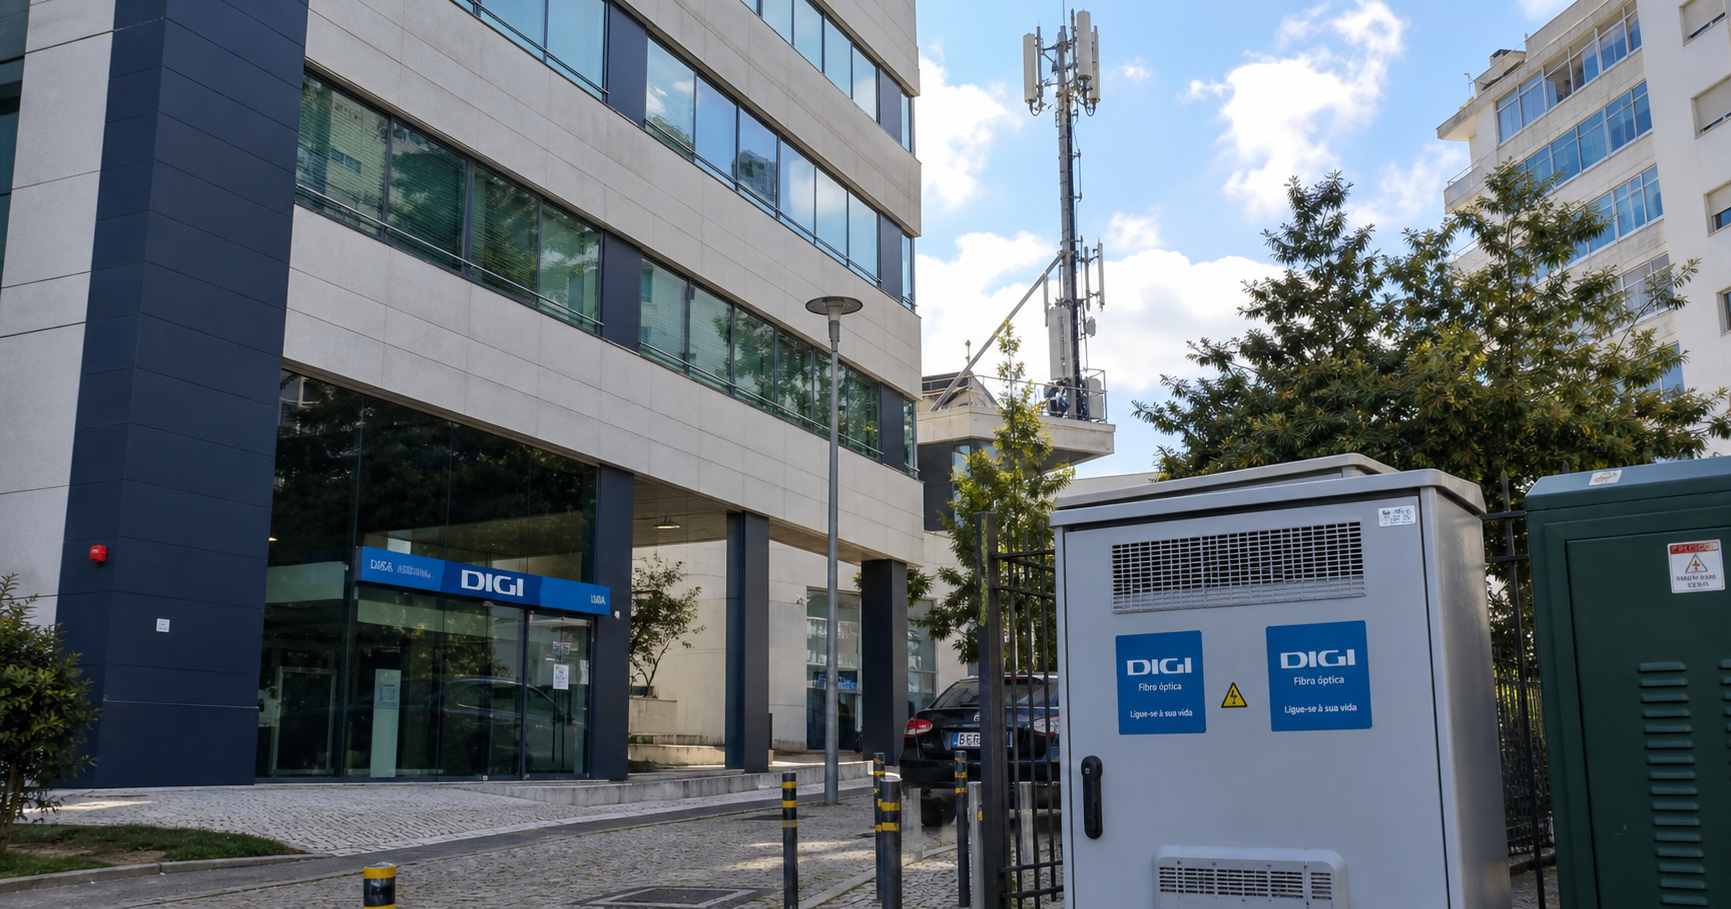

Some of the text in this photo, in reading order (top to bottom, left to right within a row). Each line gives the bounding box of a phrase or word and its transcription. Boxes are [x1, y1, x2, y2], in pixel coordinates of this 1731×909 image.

[461, 569, 524, 597] DIGI
[1280, 649, 1356, 669] DIGI
[1127, 657, 1192, 676] DIGI
[1158, 682, 1182, 692] óptica
[1293, 675, 1345, 686] Fibra óptica
[1130, 710, 1158, 720] Ligue-se
[1177, 708, 1193, 717] vida
[1284, 705, 1317, 716] Ligue-se
[1340, 703, 1357, 712] vida
